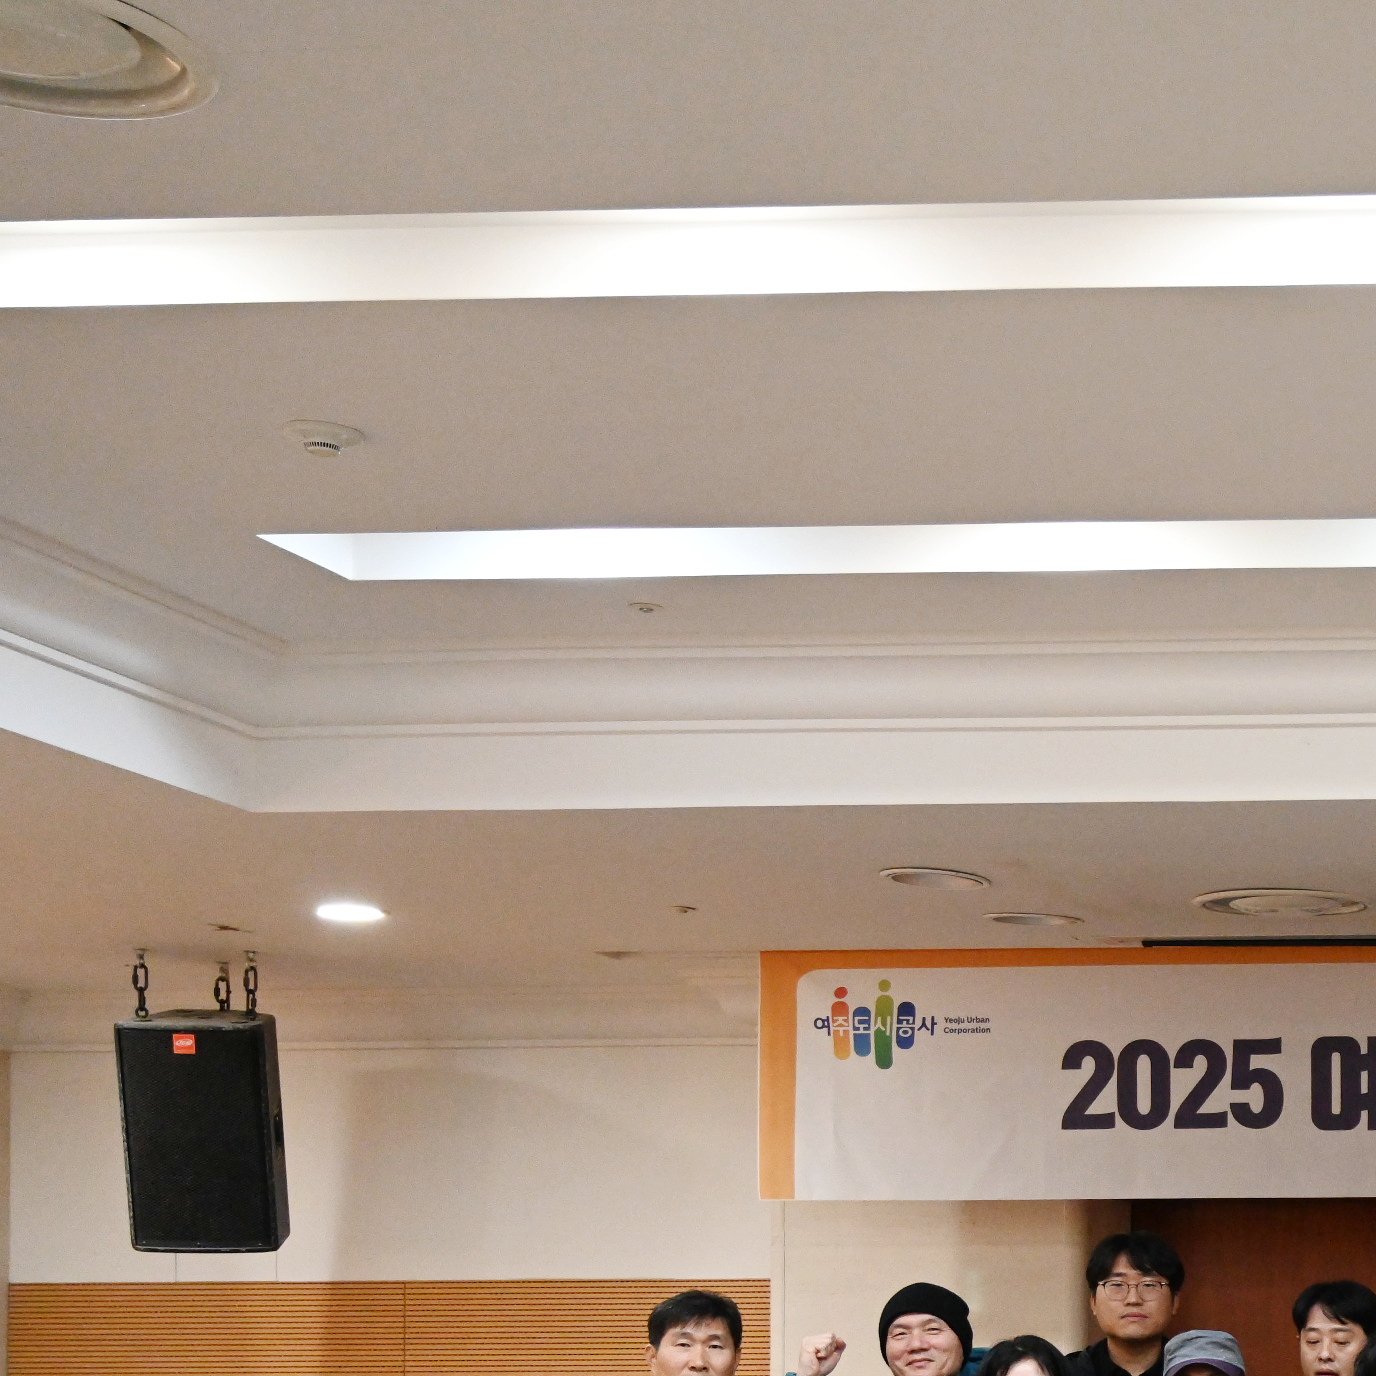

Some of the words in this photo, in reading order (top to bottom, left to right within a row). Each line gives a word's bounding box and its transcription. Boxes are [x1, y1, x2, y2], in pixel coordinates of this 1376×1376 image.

[814, 1016, 937, 1037] 여주도시공사
[944, 1016, 965, 1026] Yeoju
[967, 1016, 990, 1024] Urban
[944, 1026, 991, 1035] Corporation
[1062, 1037, 1283, 1130] 2025
